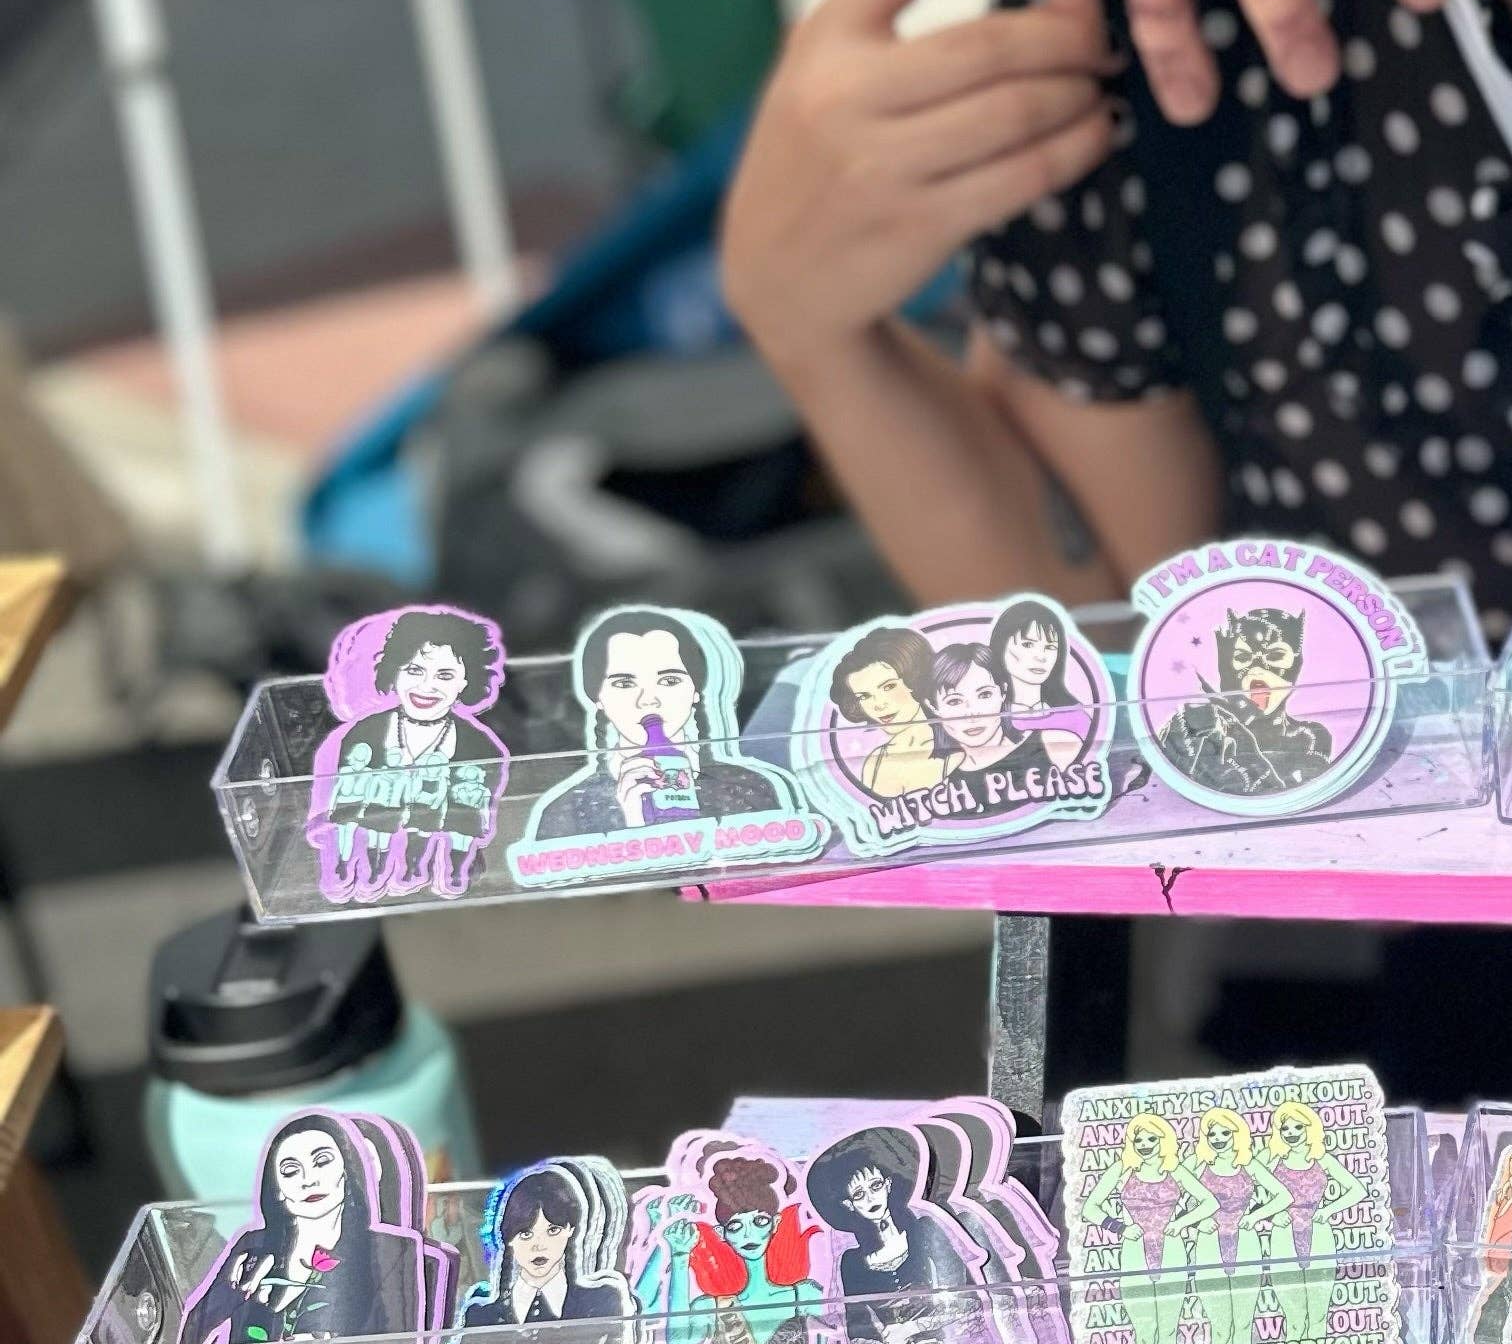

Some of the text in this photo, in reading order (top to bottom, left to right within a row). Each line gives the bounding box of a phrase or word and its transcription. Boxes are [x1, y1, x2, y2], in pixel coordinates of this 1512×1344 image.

[1147, 542, 1408, 651] I'M A CAT PERSON
[868, 761, 1104, 835] WITCH, PLEASE
[517, 819, 806, 876] WEDNESDAY MOOD
[1078, 1078, 1372, 1122] ANXIETY IS A WORKOUT.
